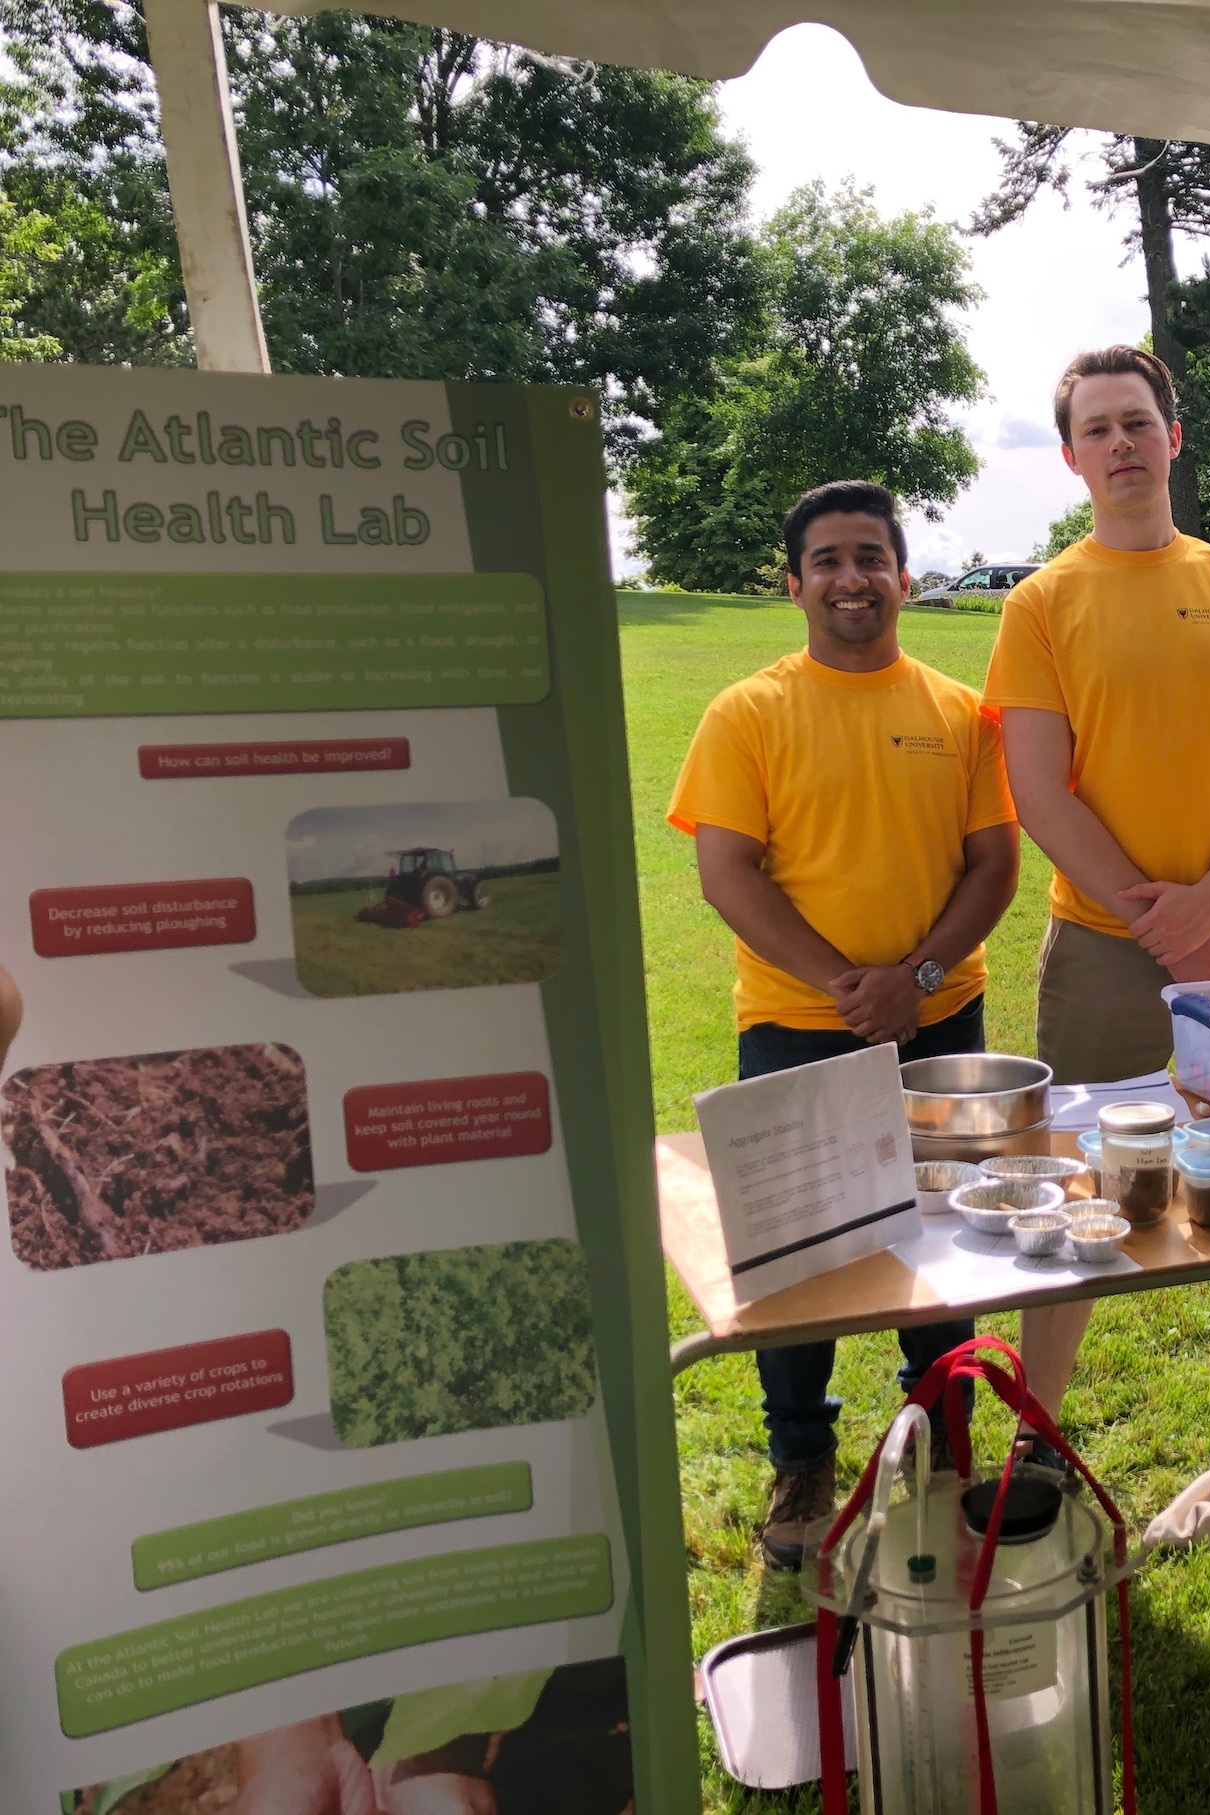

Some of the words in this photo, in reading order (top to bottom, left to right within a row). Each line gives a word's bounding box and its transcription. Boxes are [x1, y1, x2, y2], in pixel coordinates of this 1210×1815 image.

[119, 409, 380, 469] Atlantic
[401, 419, 509, 470] Soil
[72, 488, 295, 544] Health
[320, 493, 431, 547] Lab
[904, 735, 945, 743] DALHOUSIE
[159, 756, 190, 768] How
[195, 756, 220, 767] can
[225, 754, 249, 766] soil
[253, 752, 298, 765] health
[302, 752, 319, 763] be
[324, 748, 393, 764] improved?
[48, 905, 118, 921] Decrease
[122, 902, 148, 916] soil
[152, 897, 238, 915] disturbance
[63, 924, 82, 939] by
[86, 921, 153, 936] reducing
[156, 914, 227, 933] ploughing
[368, 1102, 424, 1119] Maintain
[428, 1098, 463, 1113] living
[466, 1096, 499, 1108] roots
[503, 1092, 527, 1104] and
[355, 1123, 387, 1136] keep
[391, 1120, 414, 1132] soil
[417, 1114, 469, 1129] covered
[473, 1111, 500, 1125] year
[504, 1107, 542, 1121] round
[387, 1135, 417, 1148] with
[420, 1131, 455, 1148] plant
[458, 1125, 513, 1141] material
[728, 1128, 772, 1149] Aggregate
[773, 1119, 805, 1136] Stability
[90, 1387, 117, 1402] Use
[122, 1385, 131, 1396] a
[135, 1373, 186, 1393] variety
[190, 1367, 206, 1381] of
[209, 1362, 248, 1378] crops
[251, 1359, 267, 1370] to
[75, 1404, 124, 1423] create
[128, 1393, 181, 1412] diverse
[184, 1386, 217, 1401] crop
[220, 1371, 284, 1393] rotations
[292, 1509, 315, 1524] Did
[319, 1506, 342, 1519] you
[187, 1552, 202, 1566] of
[207, 1547, 229, 1561] our
[235, 1537, 267, 1554] food
[271, 1536, 281, 1545] is
[285, 1525, 327, 1545] grown
[329, 1513, 382, 1532] directly
[386, 1510, 399, 1520] or
[404, 1497, 465, 1516] indirectly
[470, 1496, 482, 1505] in
[66, 1660, 82, 1675] At
[87, 1653, 112, 1669] the
[115, 1637, 169, 1661] Atlantic
[173, 1628, 200, 1642] Soil
[204, 1613, 250, 1634] Health
[255, 1606, 280, 1621] Lab
[283, 1601, 303, 1614] we
[307, 1595, 330, 1608] are
[333, 1579, 399, 1601] collecting
[402, 1573, 424, 1586] soil
[429, 1567, 459, 1580] from
[464, 1561, 500, 1575] farms
[503, 1557, 518, 1569] all
[522, 1555, 549, 1567] over
[553, 1547, 601, 1561] Atlantic
[74, 1666, 128, 1690] Canada
[132, 1660, 147, 1673] to
[152, 1646, 195, 1668] better
[200, 1623, 276, 1653] understand
[281, 1616, 308, 1630] how
[313, 1603, 363, 1621] healthy
[367, 1599, 380, 1609] or
[384, 1585, 449, 1606] unhealthy
[453, 1582, 473, 1592] our
[478, 1576, 500, 1588] soil
[504, 1575, 514, 1584] is
[518, 1570, 542, 1582] and
[545, 1565, 575, 1577] what
[580, 1563, 597, 1573] we
[86, 1689, 112, 1704] can
[117, 1682, 134, 1696] do
[138, 1675, 153, 1688] to
[157, 1663, 195, 1682] make
[200, 1652, 231, 1671] food
[234, 1633, 308, 1662] production
[312, 1625, 337, 1639] this
[341, 1614, 383, 1632] region
[387, 1606, 420, 1621] more
[424, 1592, 496, 1614] sustainable
[500, 1589, 517, 1600] for
[522, 1588, 530, 1597] a
[533, 1579, 589, 1595] healthier
